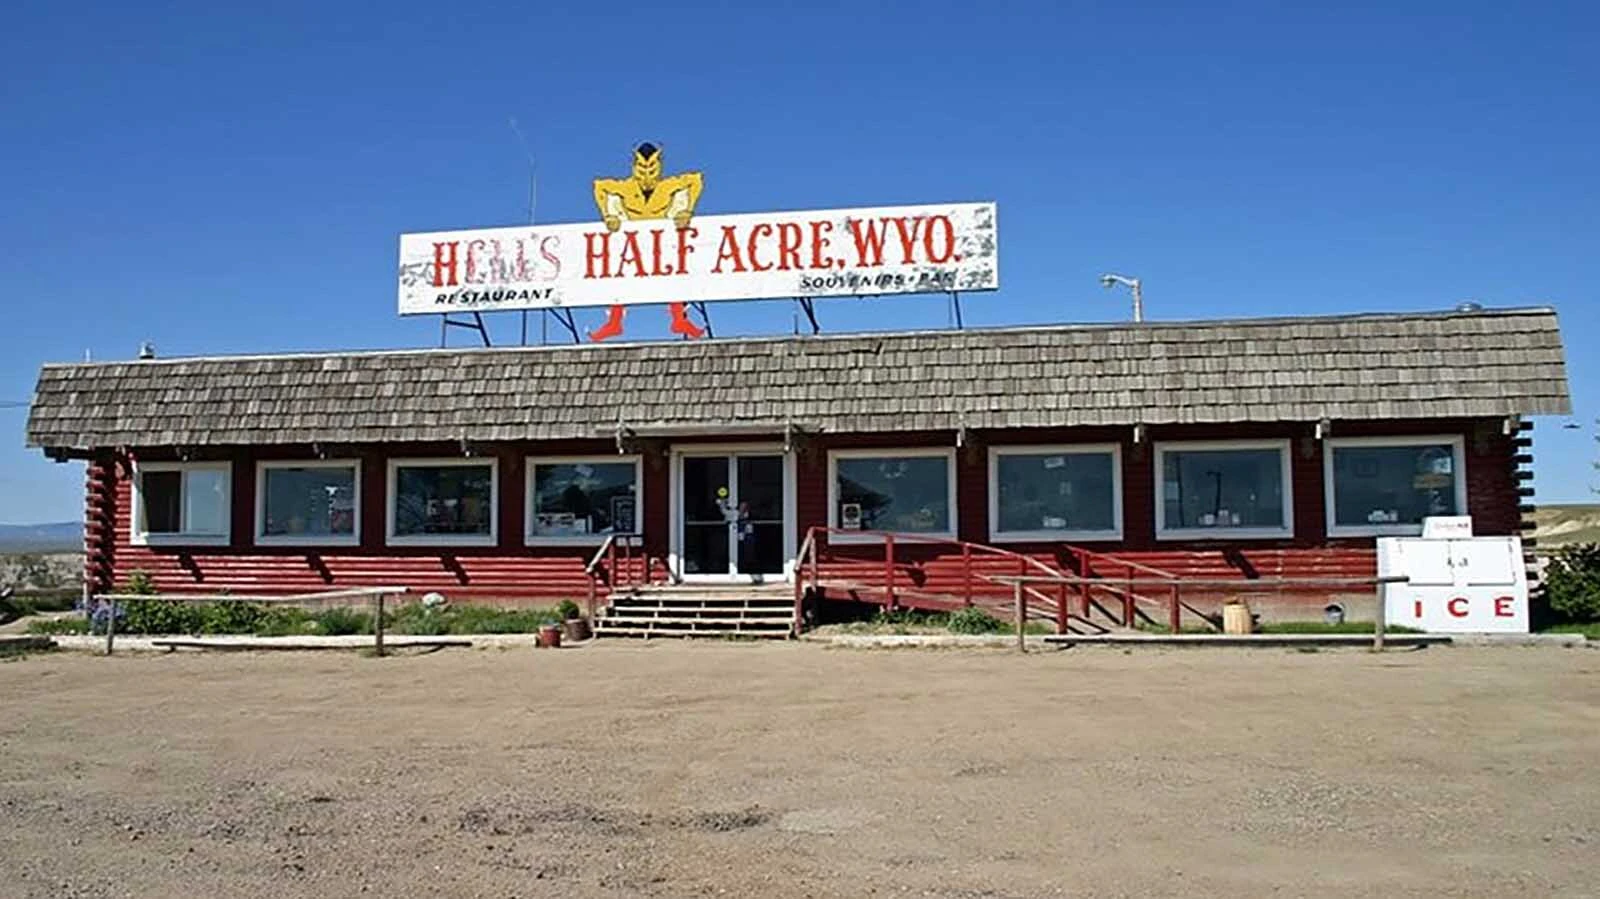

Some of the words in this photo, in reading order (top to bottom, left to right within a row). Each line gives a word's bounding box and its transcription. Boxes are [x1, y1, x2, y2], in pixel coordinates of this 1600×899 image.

[584, 228, 699, 278] HALF
[849, 215, 962, 268] WYO.
[800, 273, 904, 289] SOUVENIRS
[435, 288, 553, 304] RESTAURANT
[1415, 597, 1514, 618] ICE
